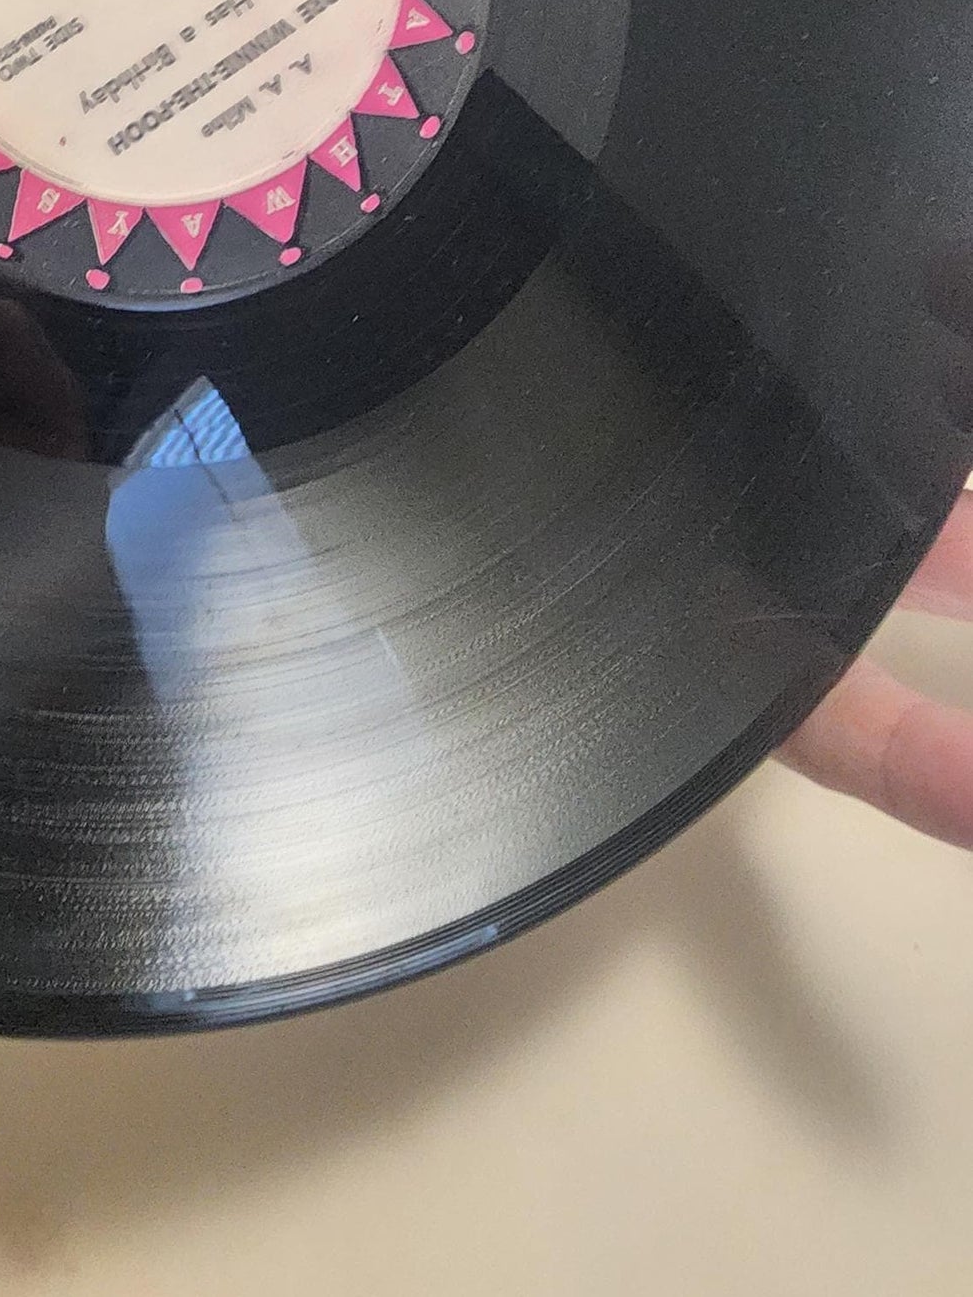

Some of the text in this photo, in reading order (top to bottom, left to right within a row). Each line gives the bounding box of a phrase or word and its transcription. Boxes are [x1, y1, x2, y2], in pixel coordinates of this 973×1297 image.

[43, 17, 84, 52] SIDE
[179, 26, 196, 43] a
[288, 53, 312, 75] A.
[79, 44, 177, 114] Birthday
[259, 74, 282, 95] A.
